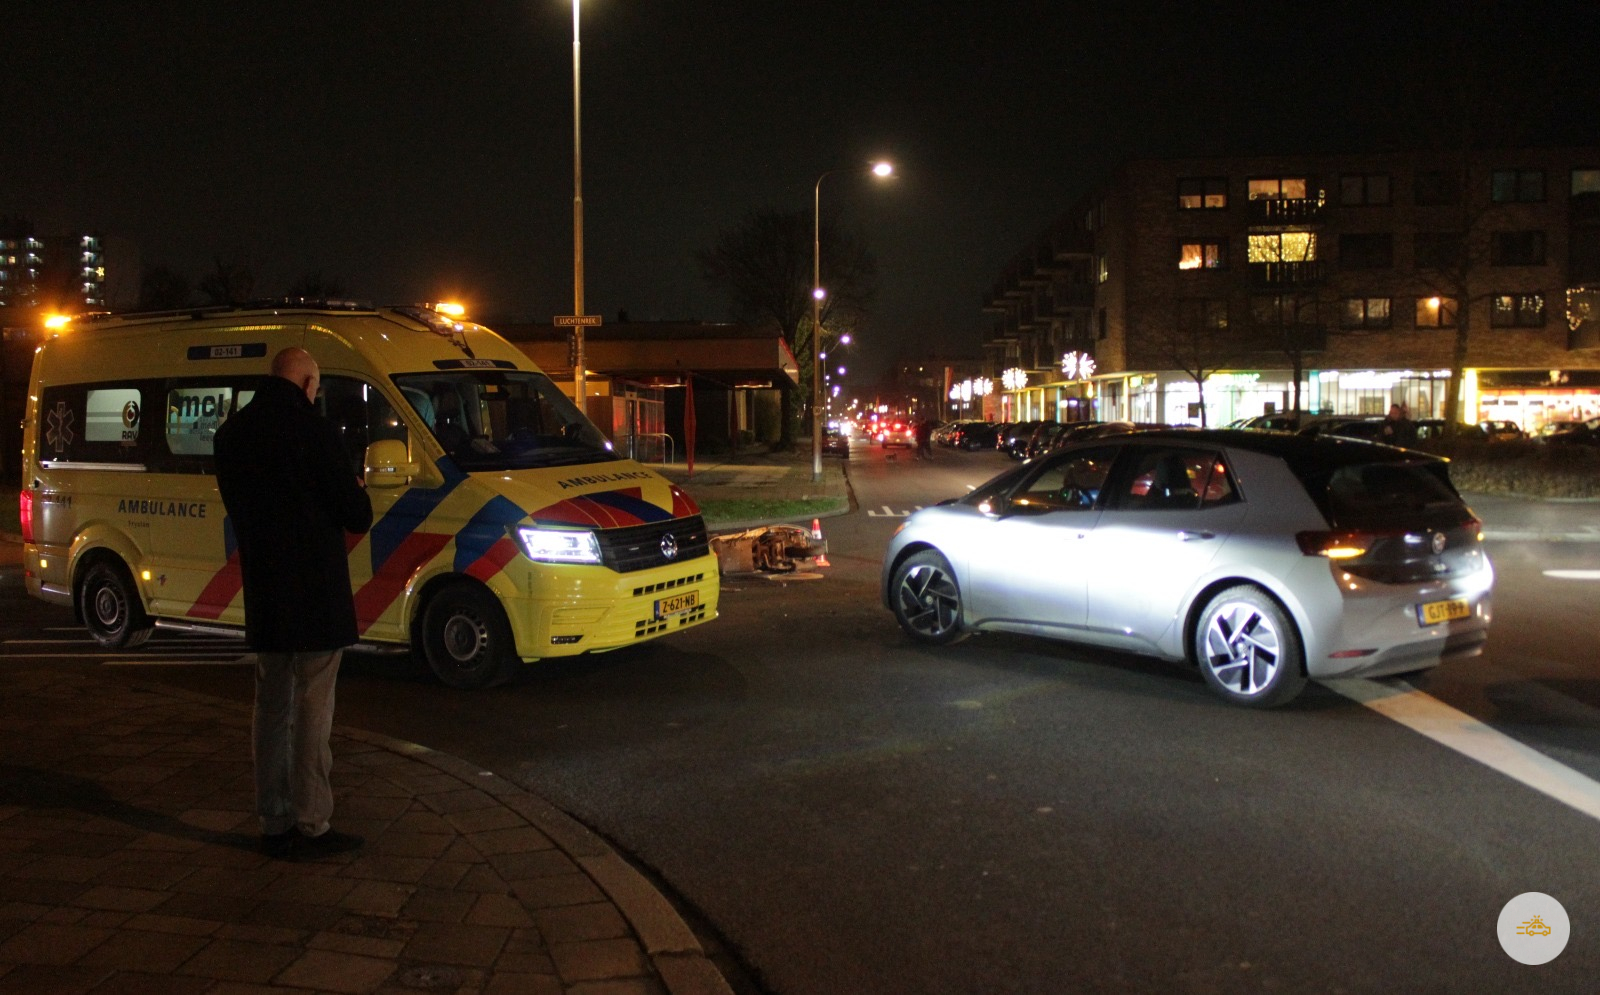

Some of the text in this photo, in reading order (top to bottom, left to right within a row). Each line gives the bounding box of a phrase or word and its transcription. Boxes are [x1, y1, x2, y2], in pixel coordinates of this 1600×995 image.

[214, 347, 237, 356] 02-141
[122, 430, 138, 440] RAV
[558, 471, 653, 489] AMBULANCE
[118, 500, 206, 518] AMBULANCE
[662, 594, 695, 613] Z-621-NB
